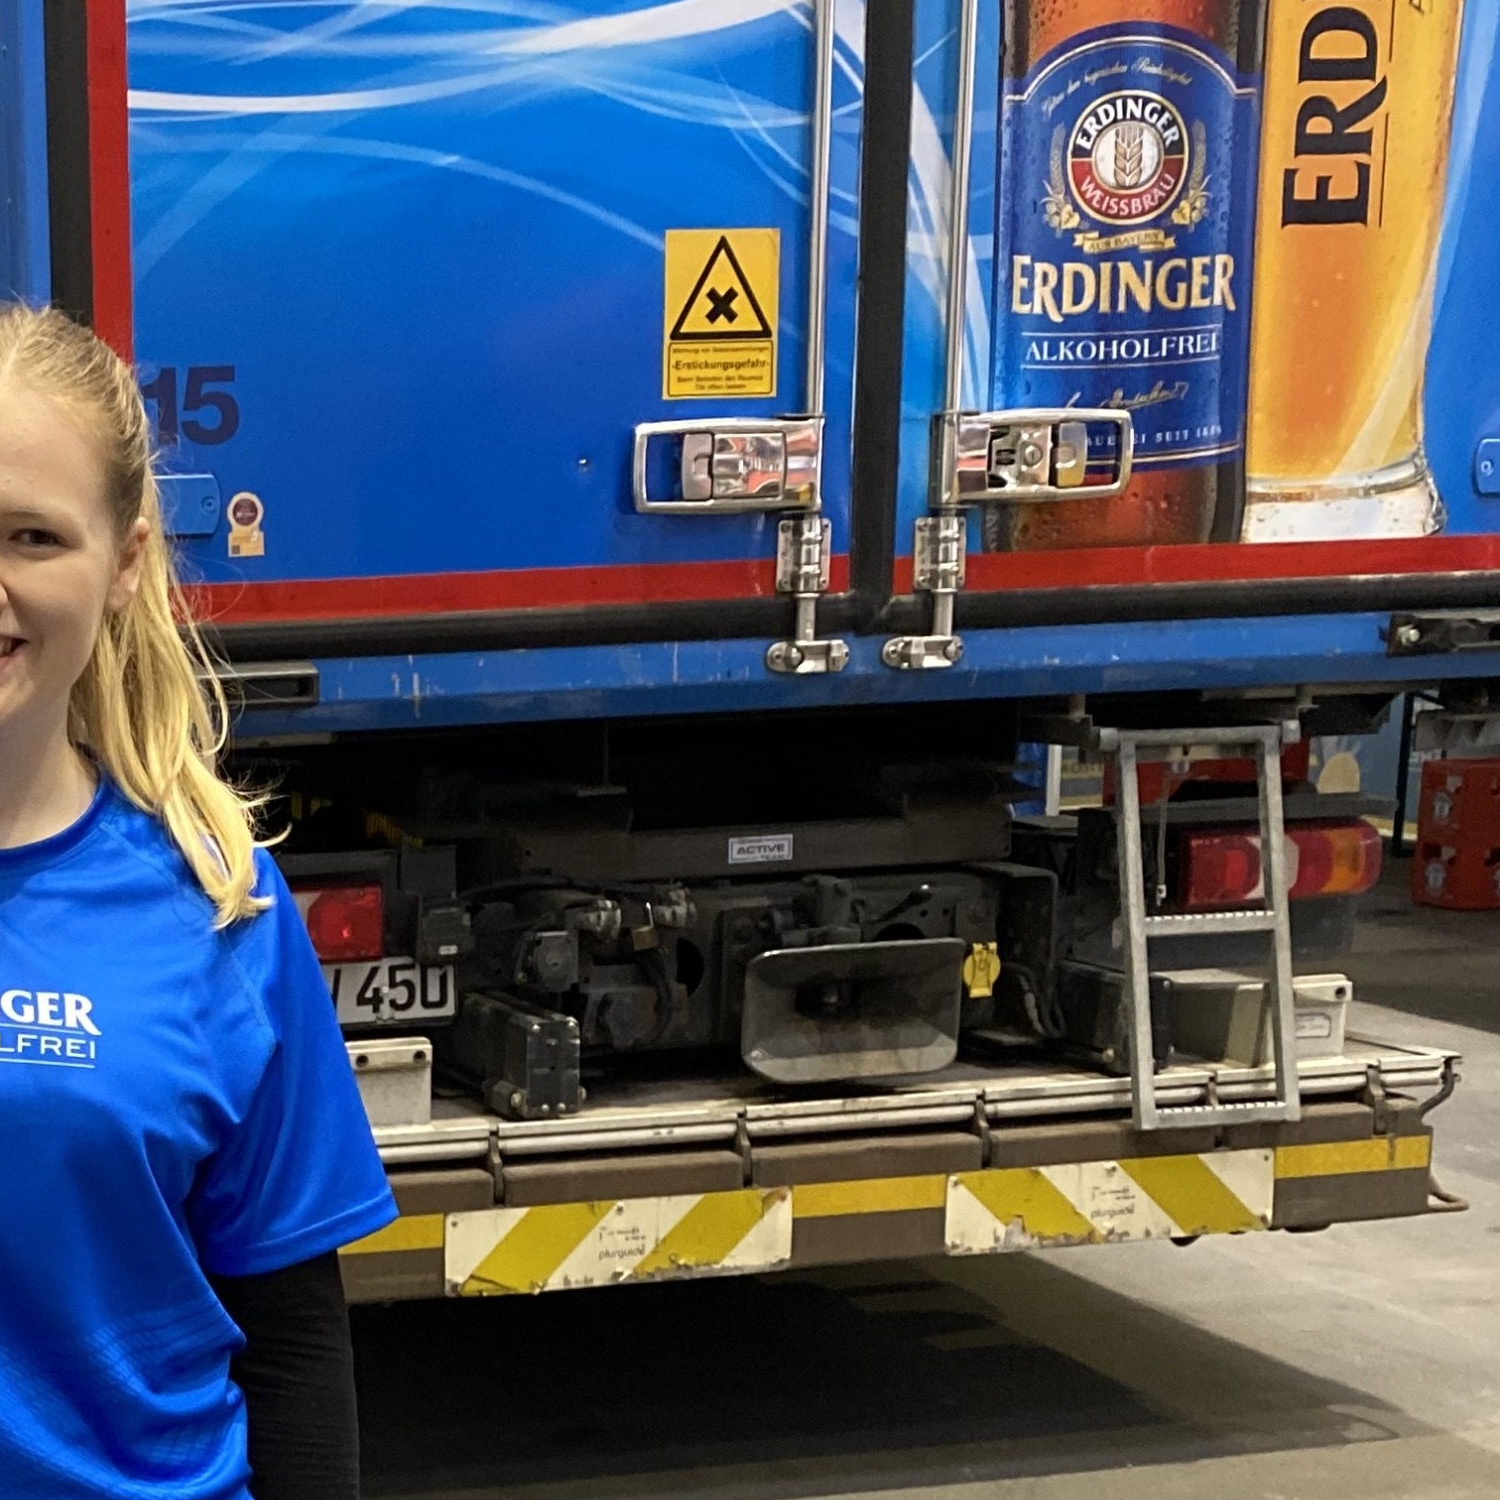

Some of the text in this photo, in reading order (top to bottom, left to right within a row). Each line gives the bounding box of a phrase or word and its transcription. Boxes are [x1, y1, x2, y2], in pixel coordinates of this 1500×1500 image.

[1076, 98, 1180, 151] ERDINGER
[1011, 253, 1237, 323] ERDINGER
[1025, 332, 1219, 361] ALKOHOLFREI
[737, 843, 785, 855] ACTIVE
